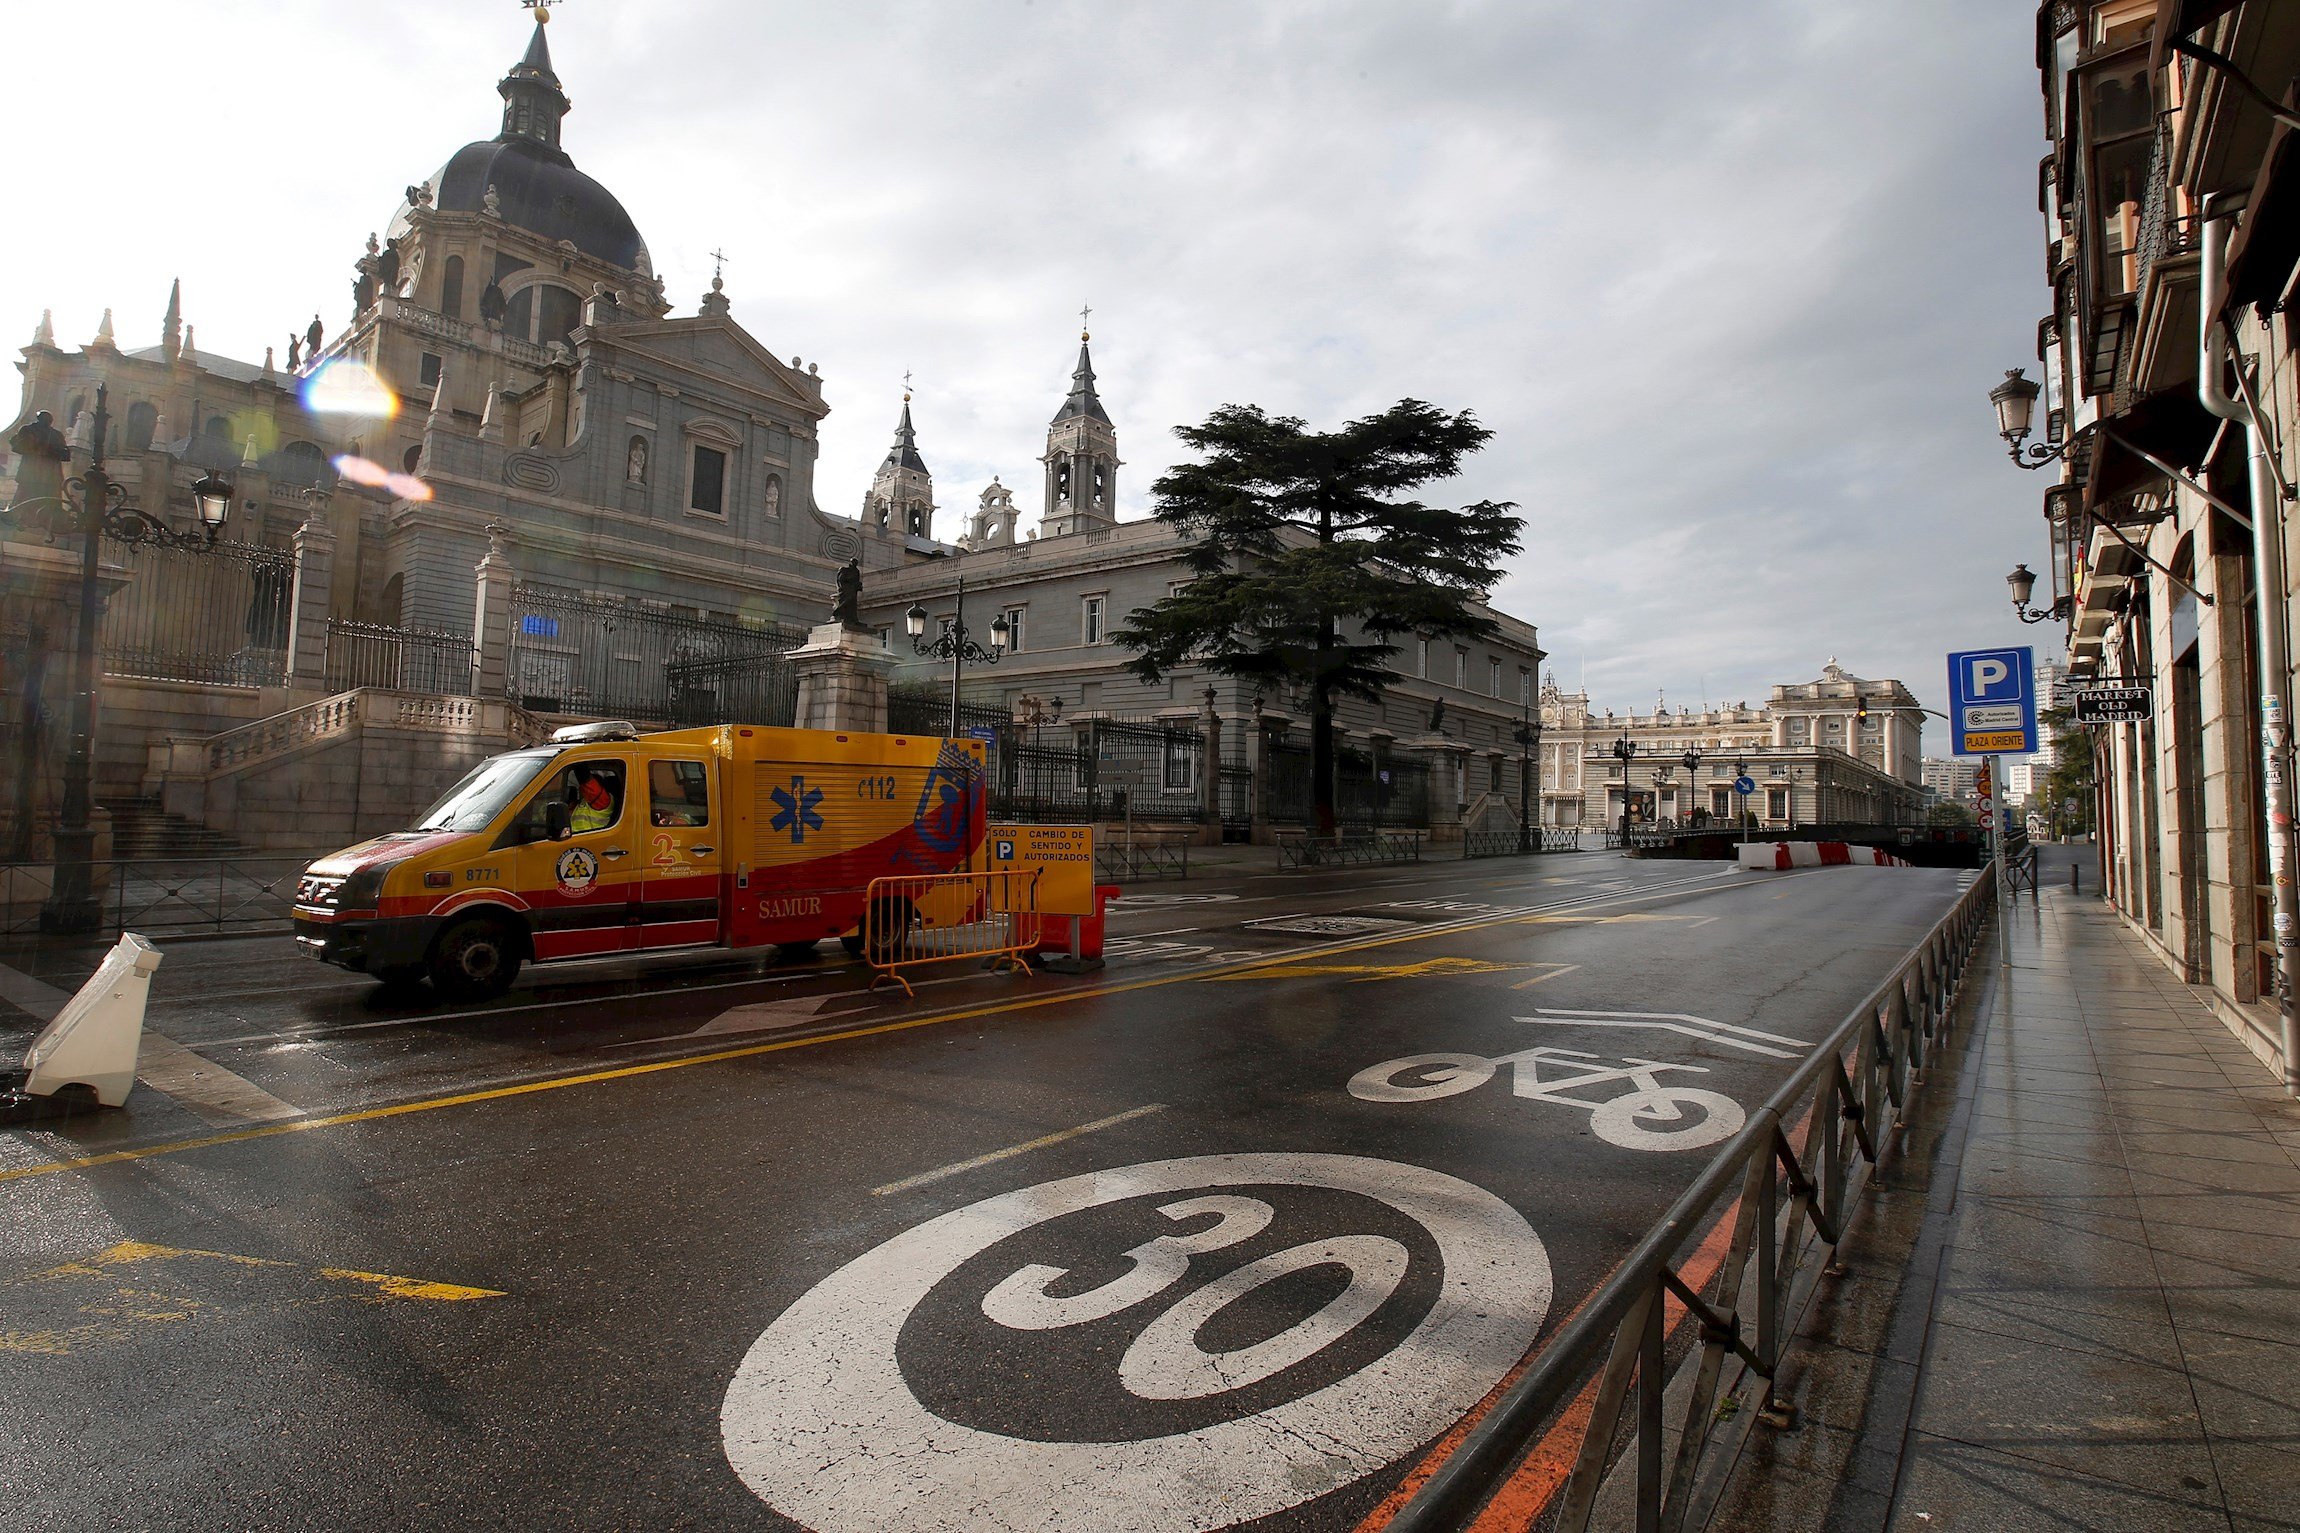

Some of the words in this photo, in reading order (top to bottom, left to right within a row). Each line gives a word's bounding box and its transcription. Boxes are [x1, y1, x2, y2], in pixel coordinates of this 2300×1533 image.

[1972, 659, 2008, 697] P
[2081, 690, 2145, 701] MARKET
[2098, 701, 2128, 711] OLD
[2085, 711, 2144, 721] MADRID
[1966, 737, 1989, 747] PLAZA
[1992, 735, 2023, 746] ORIENTE
[993, 828, 1017, 837] SÓLO
[1029, 830, 1067, 839] CAMBIO
[1072, 831, 1084, 839] DE
[1000, 842, 1012, 859] P
[1031, 842, 1071, 850] SENTIDO
[1077, 842, 1083, 850] Y
[1024, 852, 1090, 861] AUTORIZADOS
[466, 868, 499, 881] 8771
[759, 897, 822, 919] SAMUR
[980, 1194, 1410, 1400] 30
